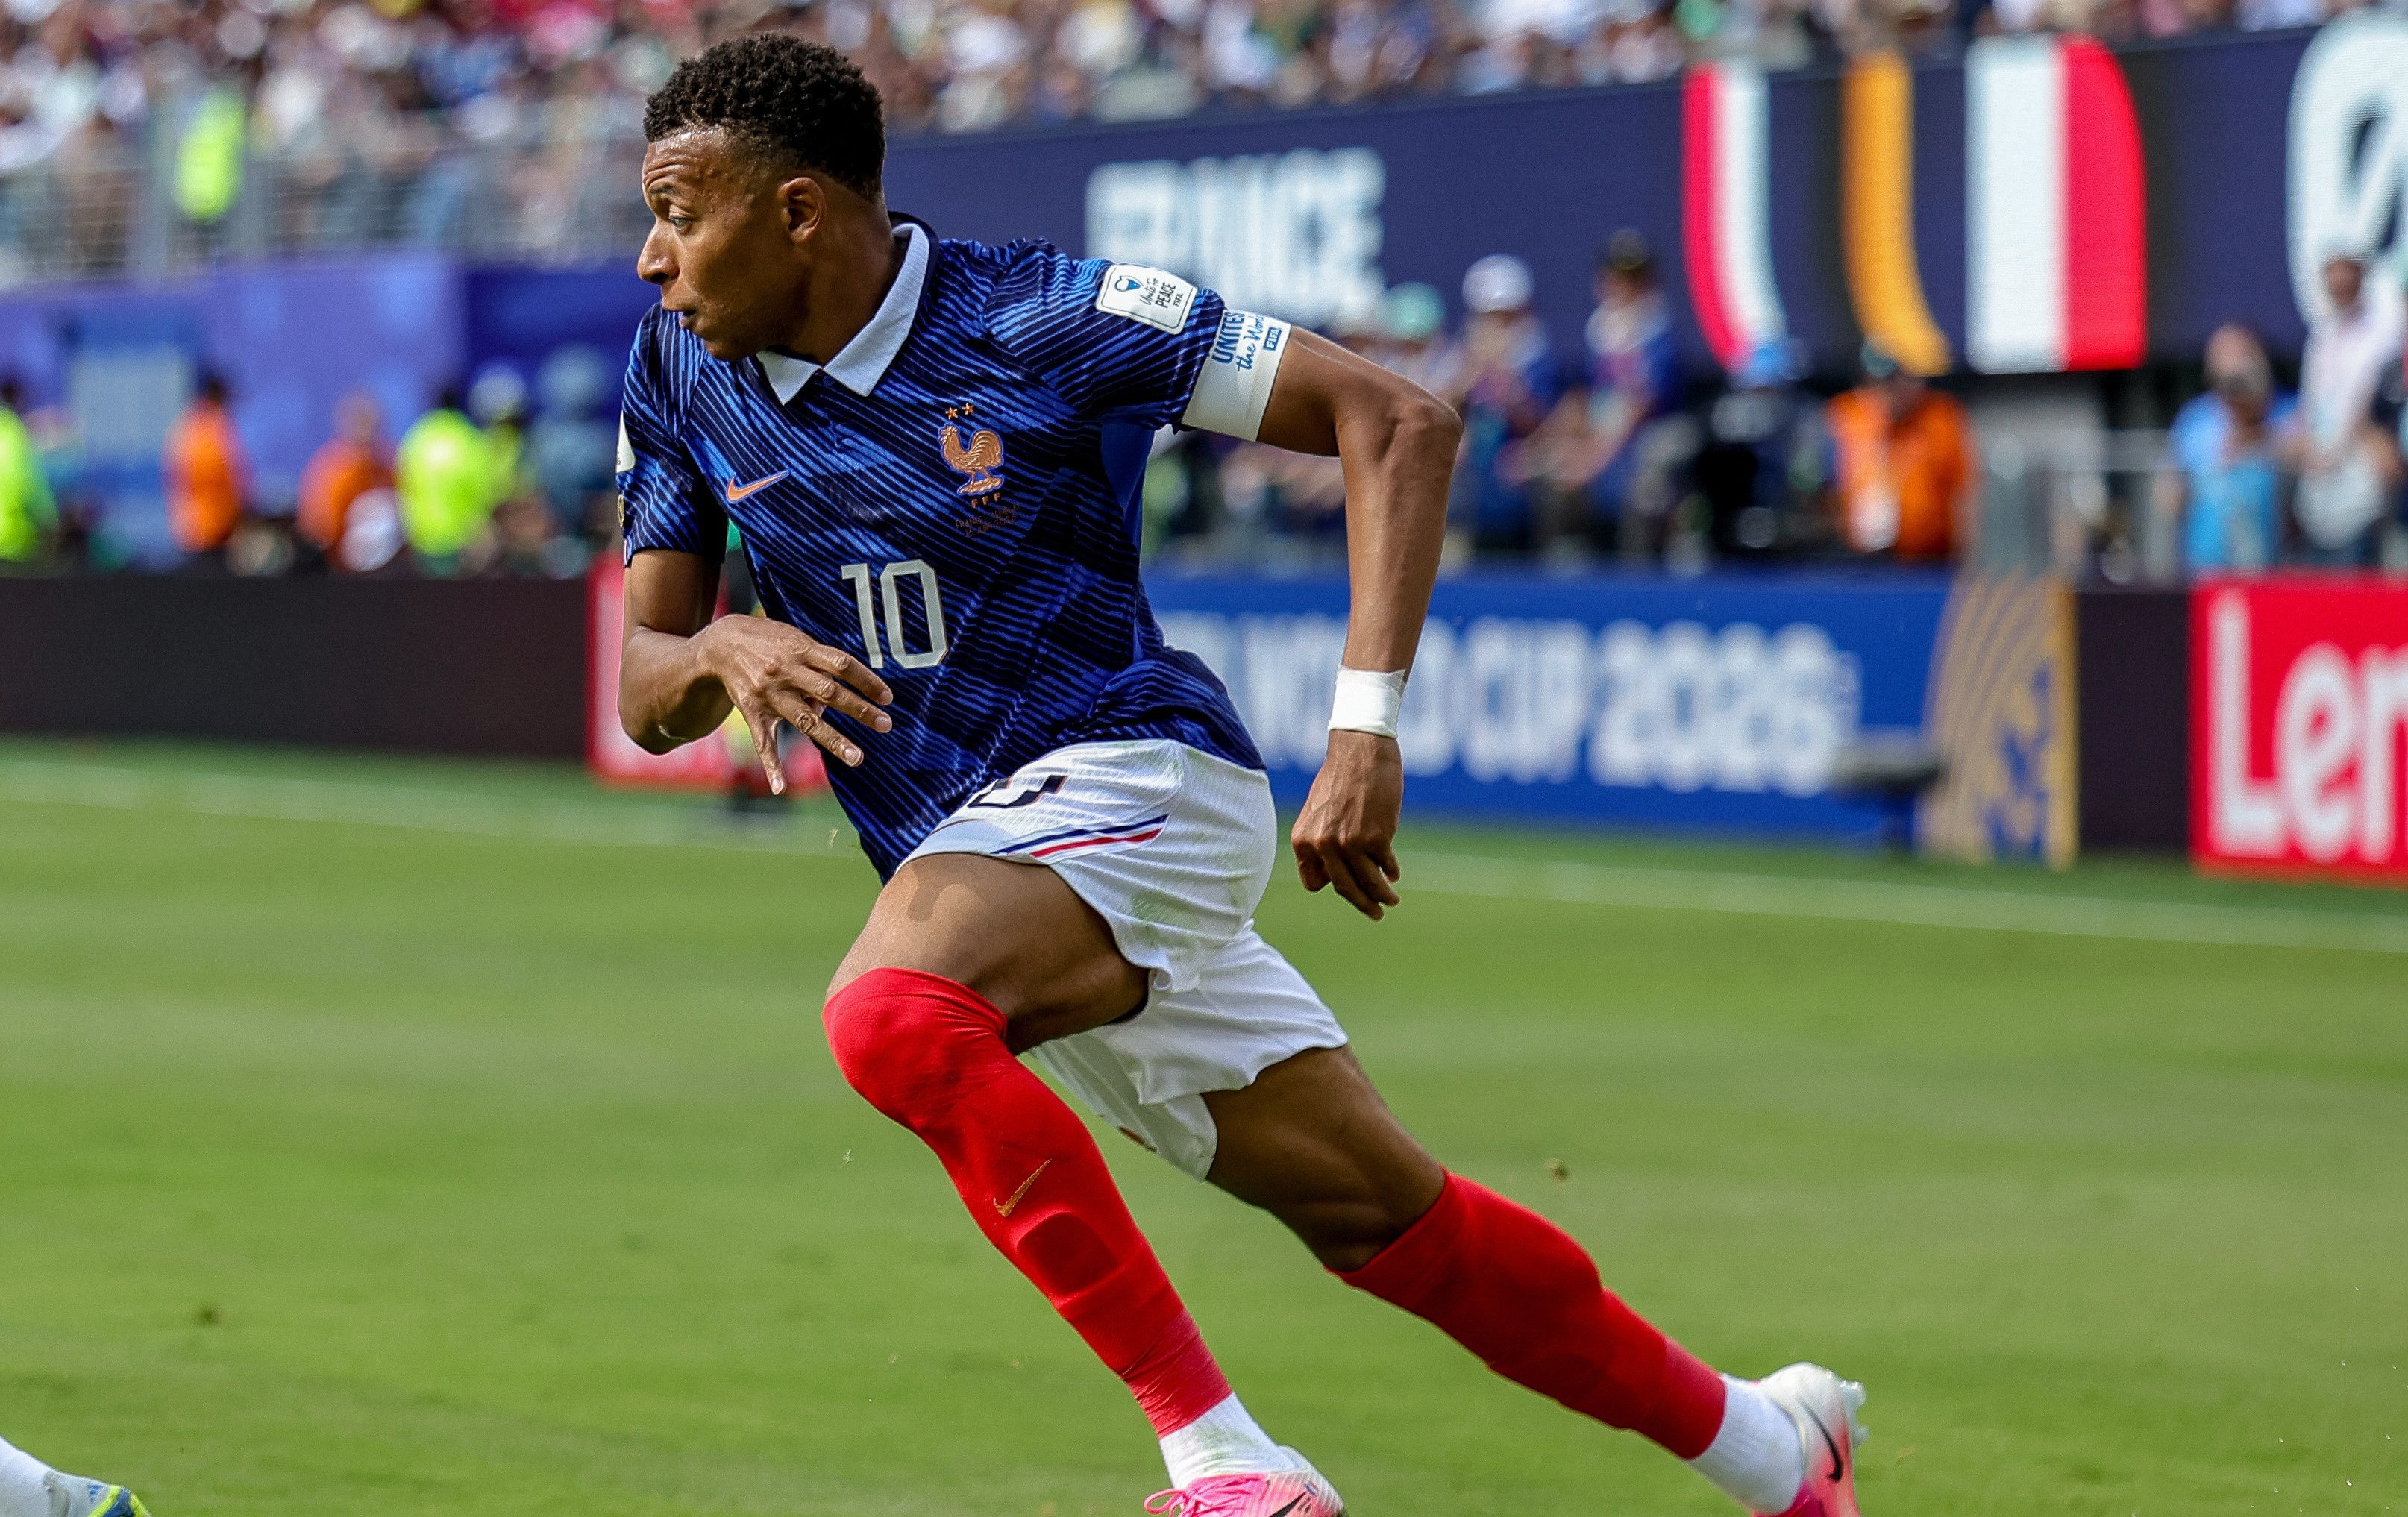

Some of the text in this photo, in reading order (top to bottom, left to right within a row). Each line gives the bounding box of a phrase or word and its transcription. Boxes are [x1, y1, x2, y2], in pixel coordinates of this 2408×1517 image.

[1155, 282, 1176, 308] PEACE
[1173, 293, 1184, 307] FIFA
[1211, 312, 1245, 364] UNITES
[1264, 327, 1281, 350] FIFA
[1235, 343, 1256, 371] the
[971, 492, 1000, 509] FFF
[841, 559, 949, 669] 10
[1462, 616, 1593, 785] CUP
[1589, 618, 1841, 798] 2026
